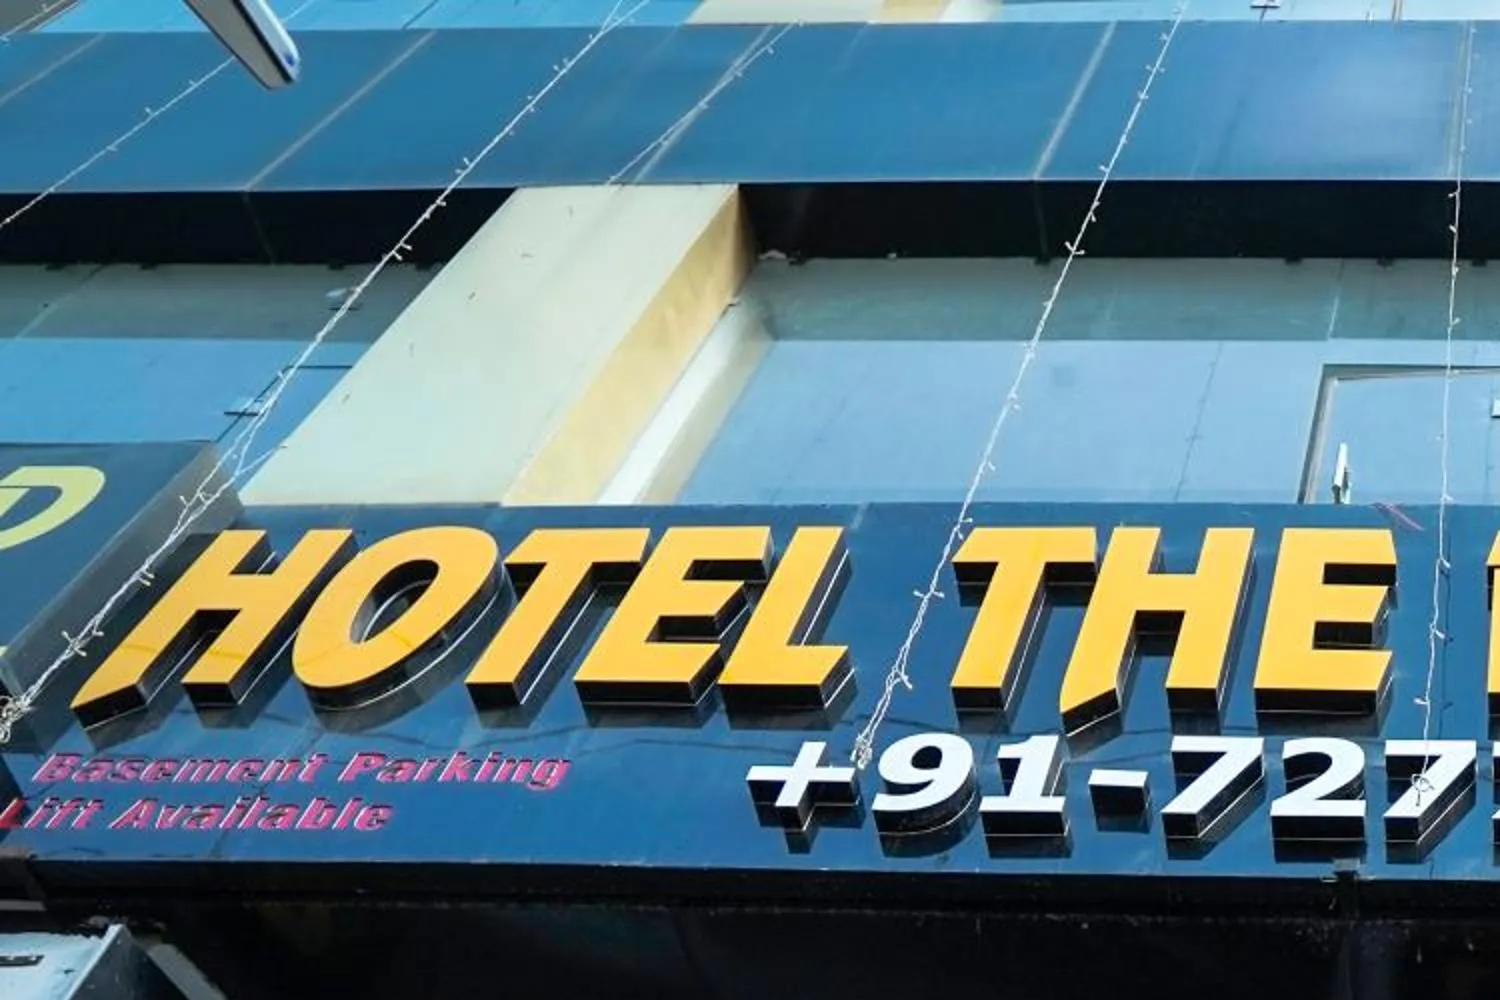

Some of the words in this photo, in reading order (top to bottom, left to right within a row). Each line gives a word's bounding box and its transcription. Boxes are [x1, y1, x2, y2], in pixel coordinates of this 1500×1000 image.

[70, 526, 849, 709] HOTEL
[951, 527, 1397, 716] THE
[32, 752, 328, 783] Basement
[337, 751, 573, 791] Parking
[0, 797, 103, 829] Lift
[108, 796, 394, 830] Available
